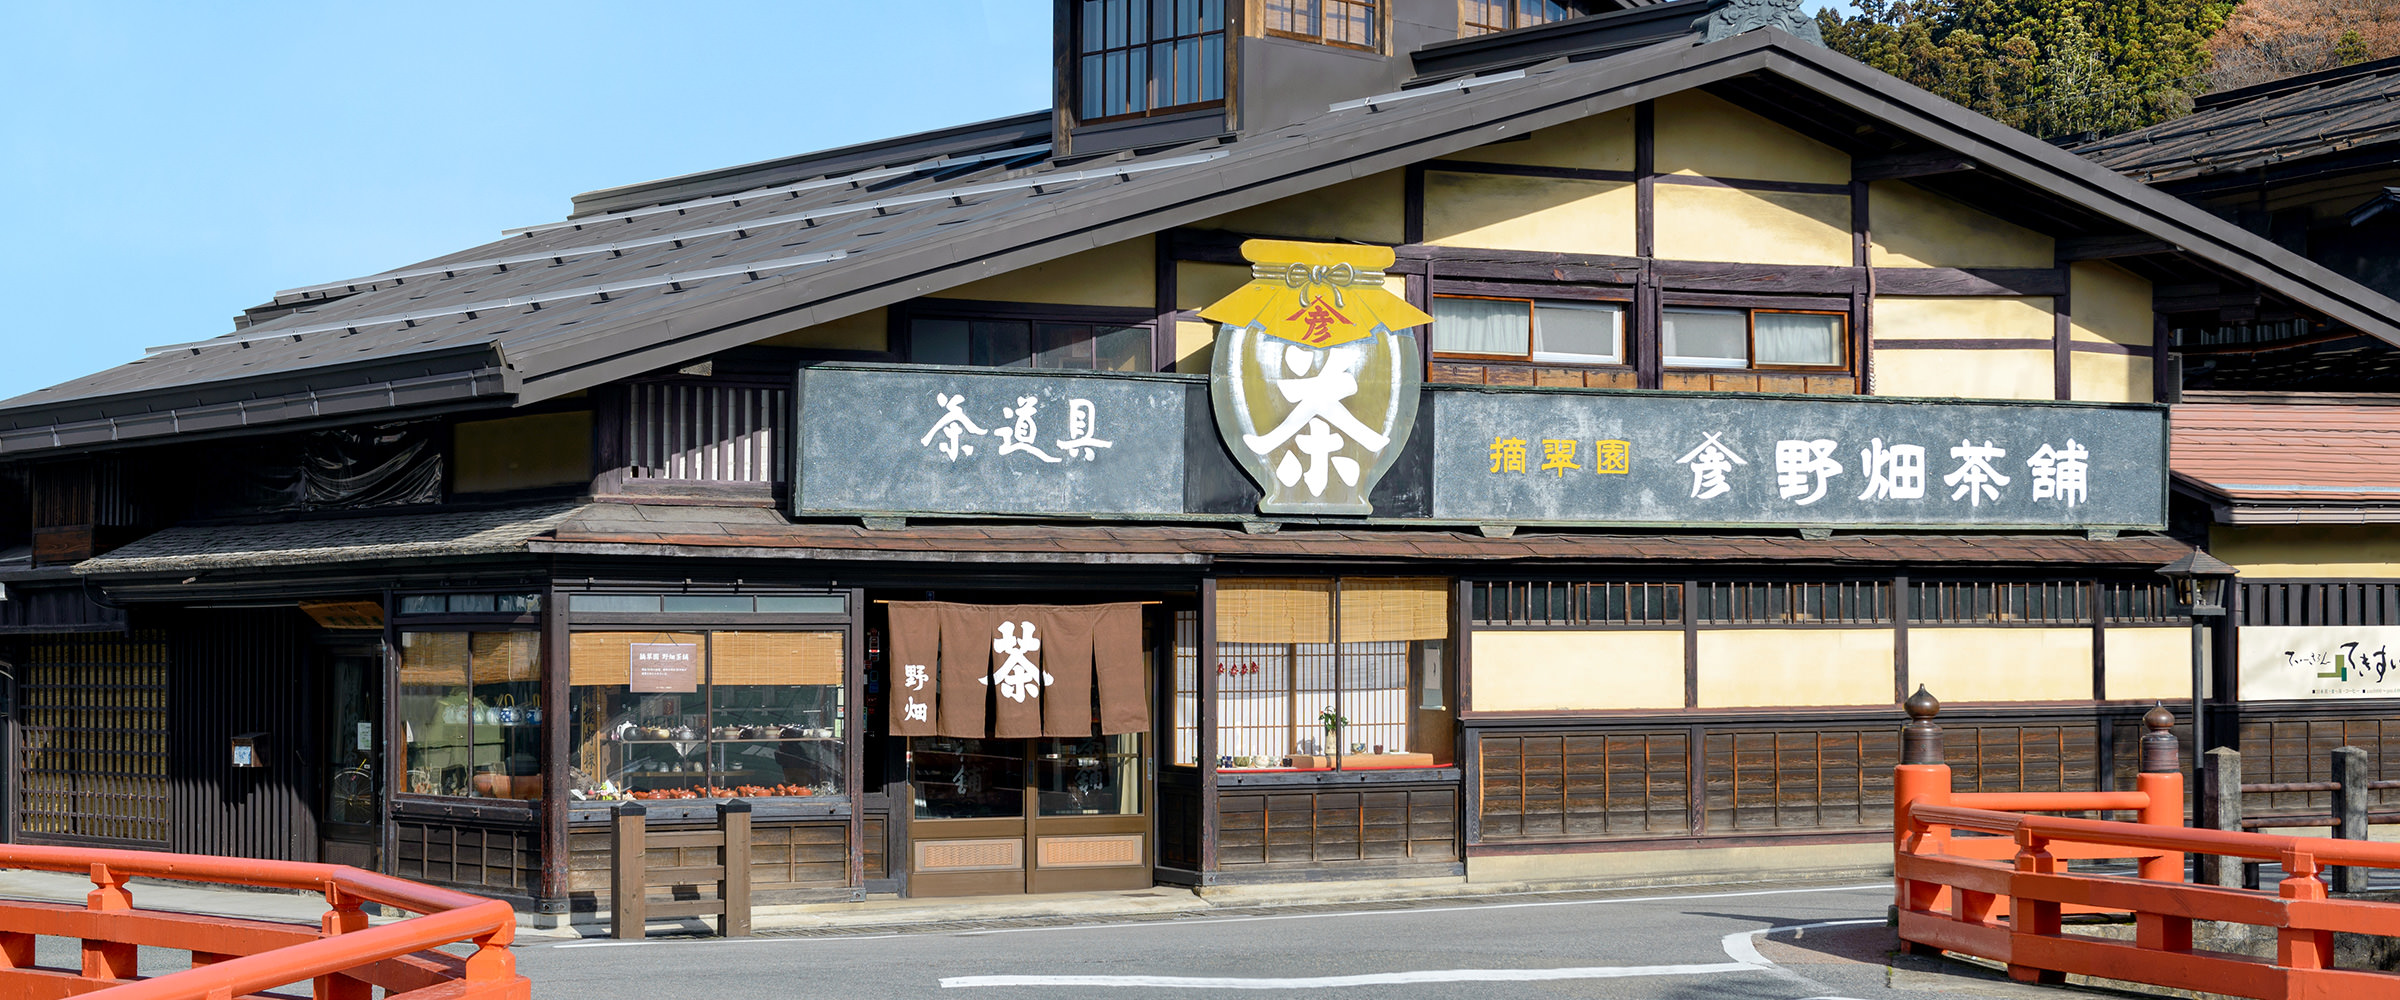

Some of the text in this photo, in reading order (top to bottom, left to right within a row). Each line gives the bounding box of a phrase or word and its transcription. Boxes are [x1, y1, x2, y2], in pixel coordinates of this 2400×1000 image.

[920, 393, 1113, 463] 茶道具
[1243, 348, 1391, 497] 茶
[1489, 436, 1632, 477] 摘翠園
[904, 664, 929, 723] 野畑
[978, 621, 1055, 703] 茶
